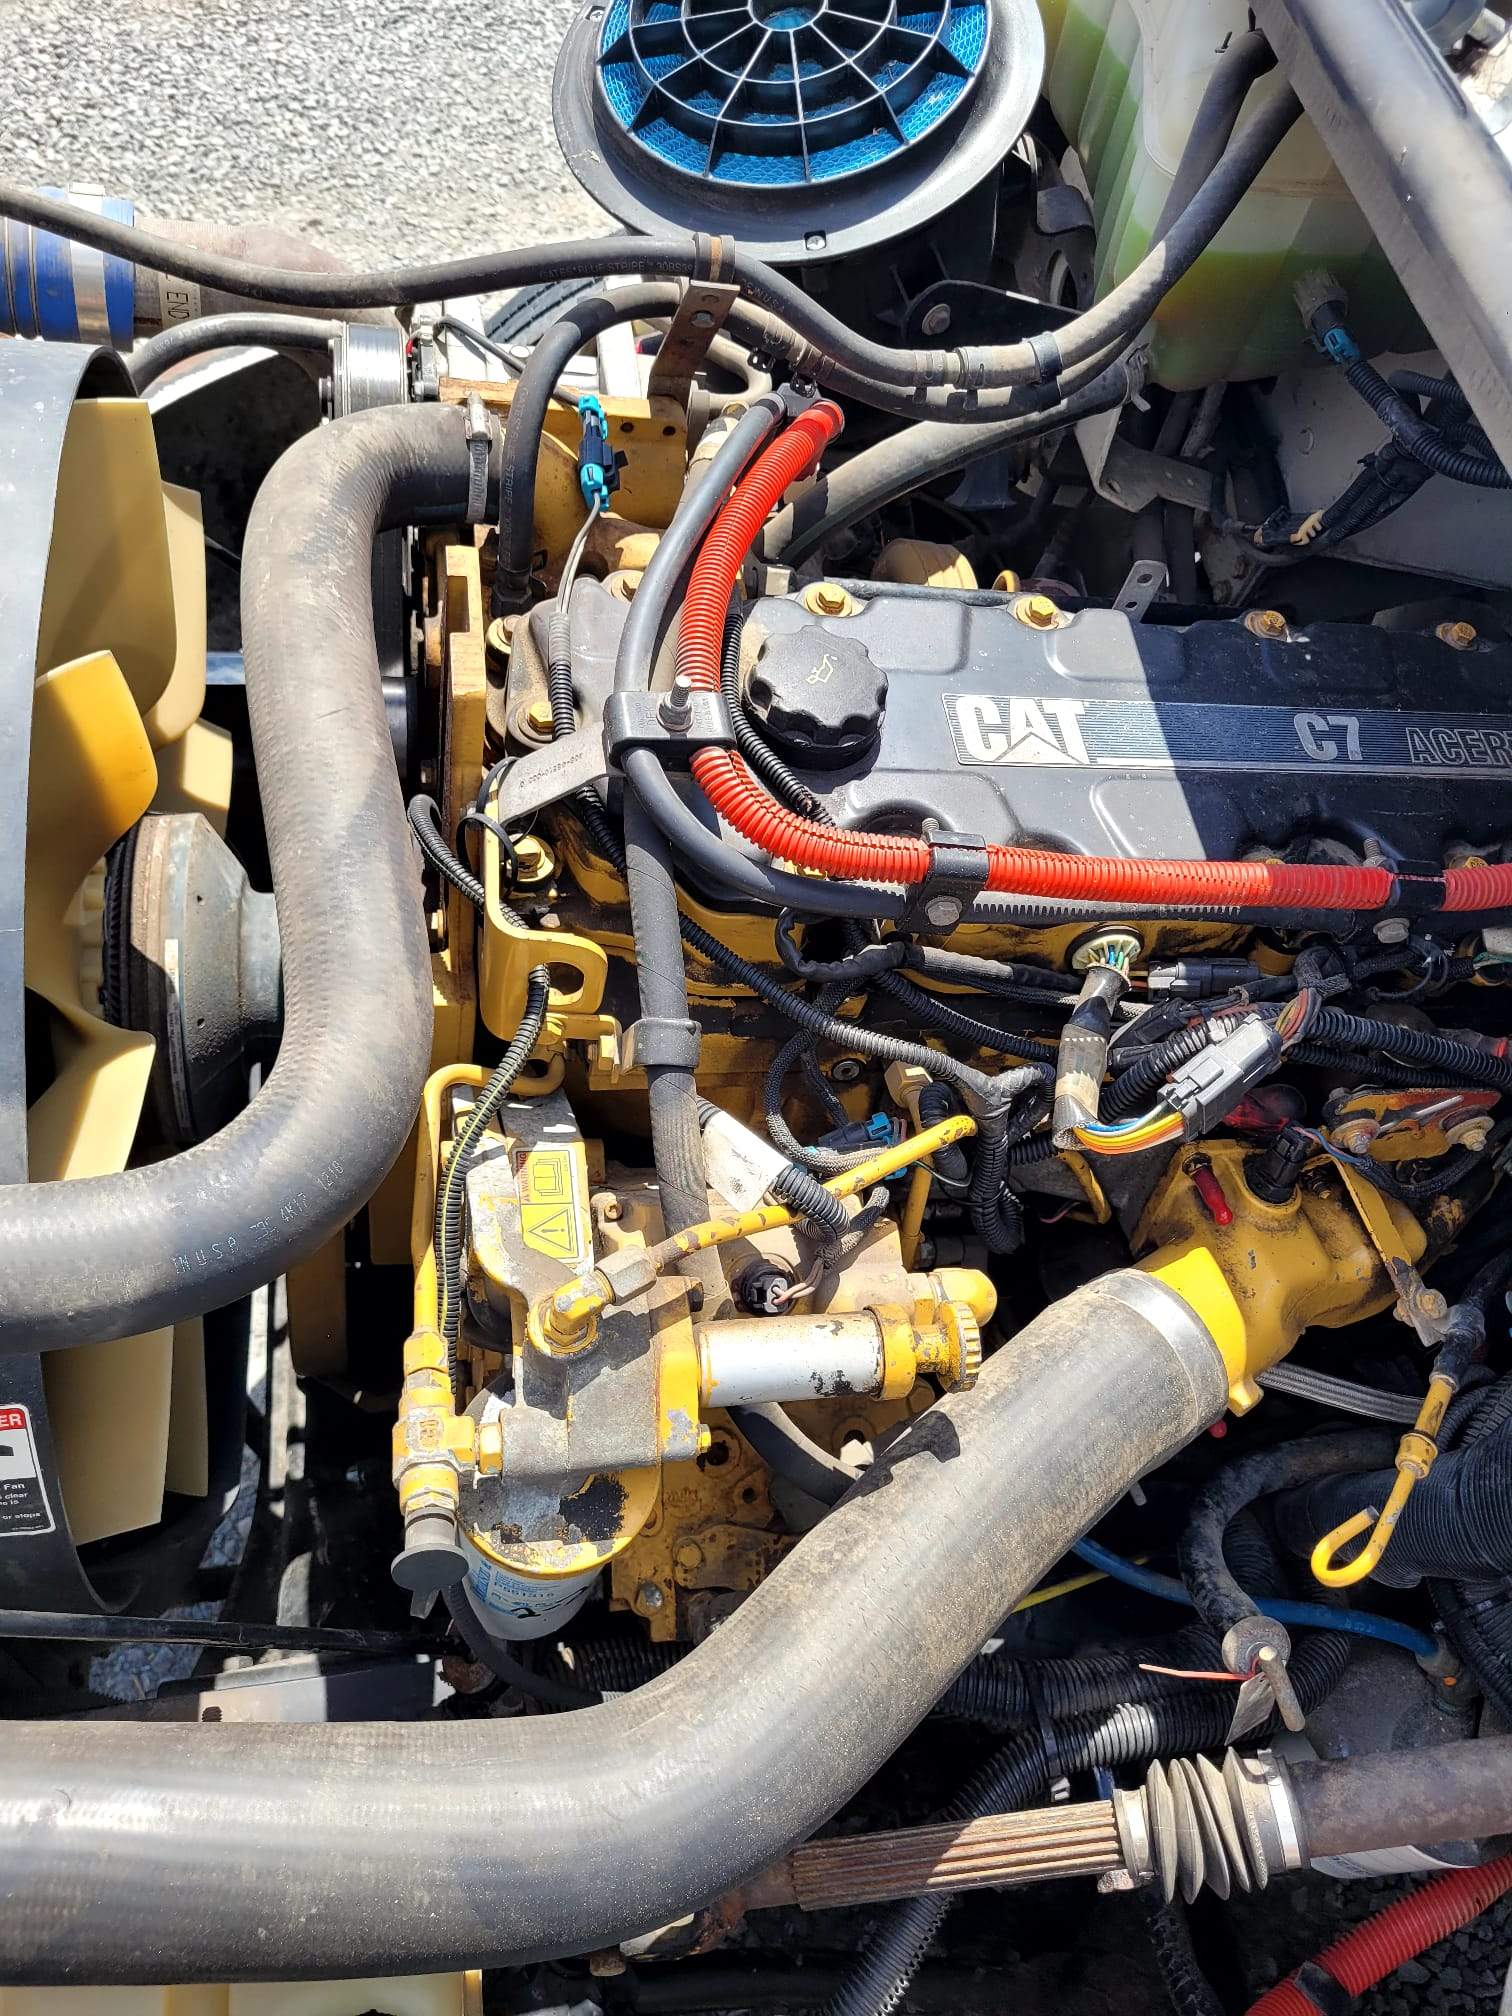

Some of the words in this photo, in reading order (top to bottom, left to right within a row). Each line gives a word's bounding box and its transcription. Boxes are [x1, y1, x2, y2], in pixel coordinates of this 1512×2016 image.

[166, 291, 190, 319] END
[955, 695, 1091, 765] CAT
[1294, 712, 1363, 761] C7
[1405, 726, 1512, 766] ACER
[3, 1483, 26, 1491] Fan
